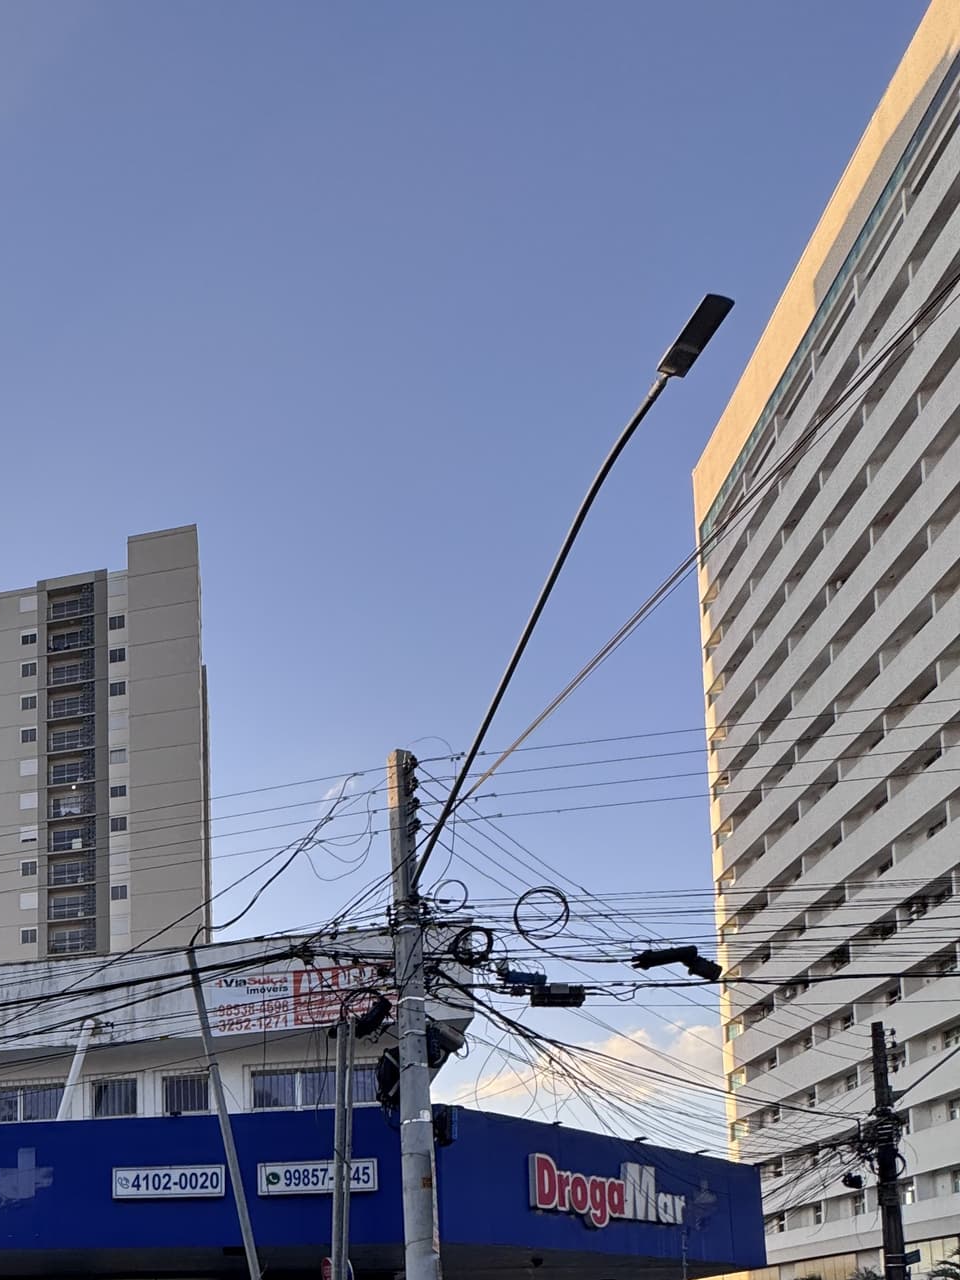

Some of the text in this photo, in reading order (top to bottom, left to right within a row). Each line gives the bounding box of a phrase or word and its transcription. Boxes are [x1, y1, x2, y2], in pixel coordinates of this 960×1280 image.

[218, 1014, 288, 1033] 3252-1271
[131, 1171, 219, 1192] 4102-0020
[283, 1166, 371, 1188] 99857-45
